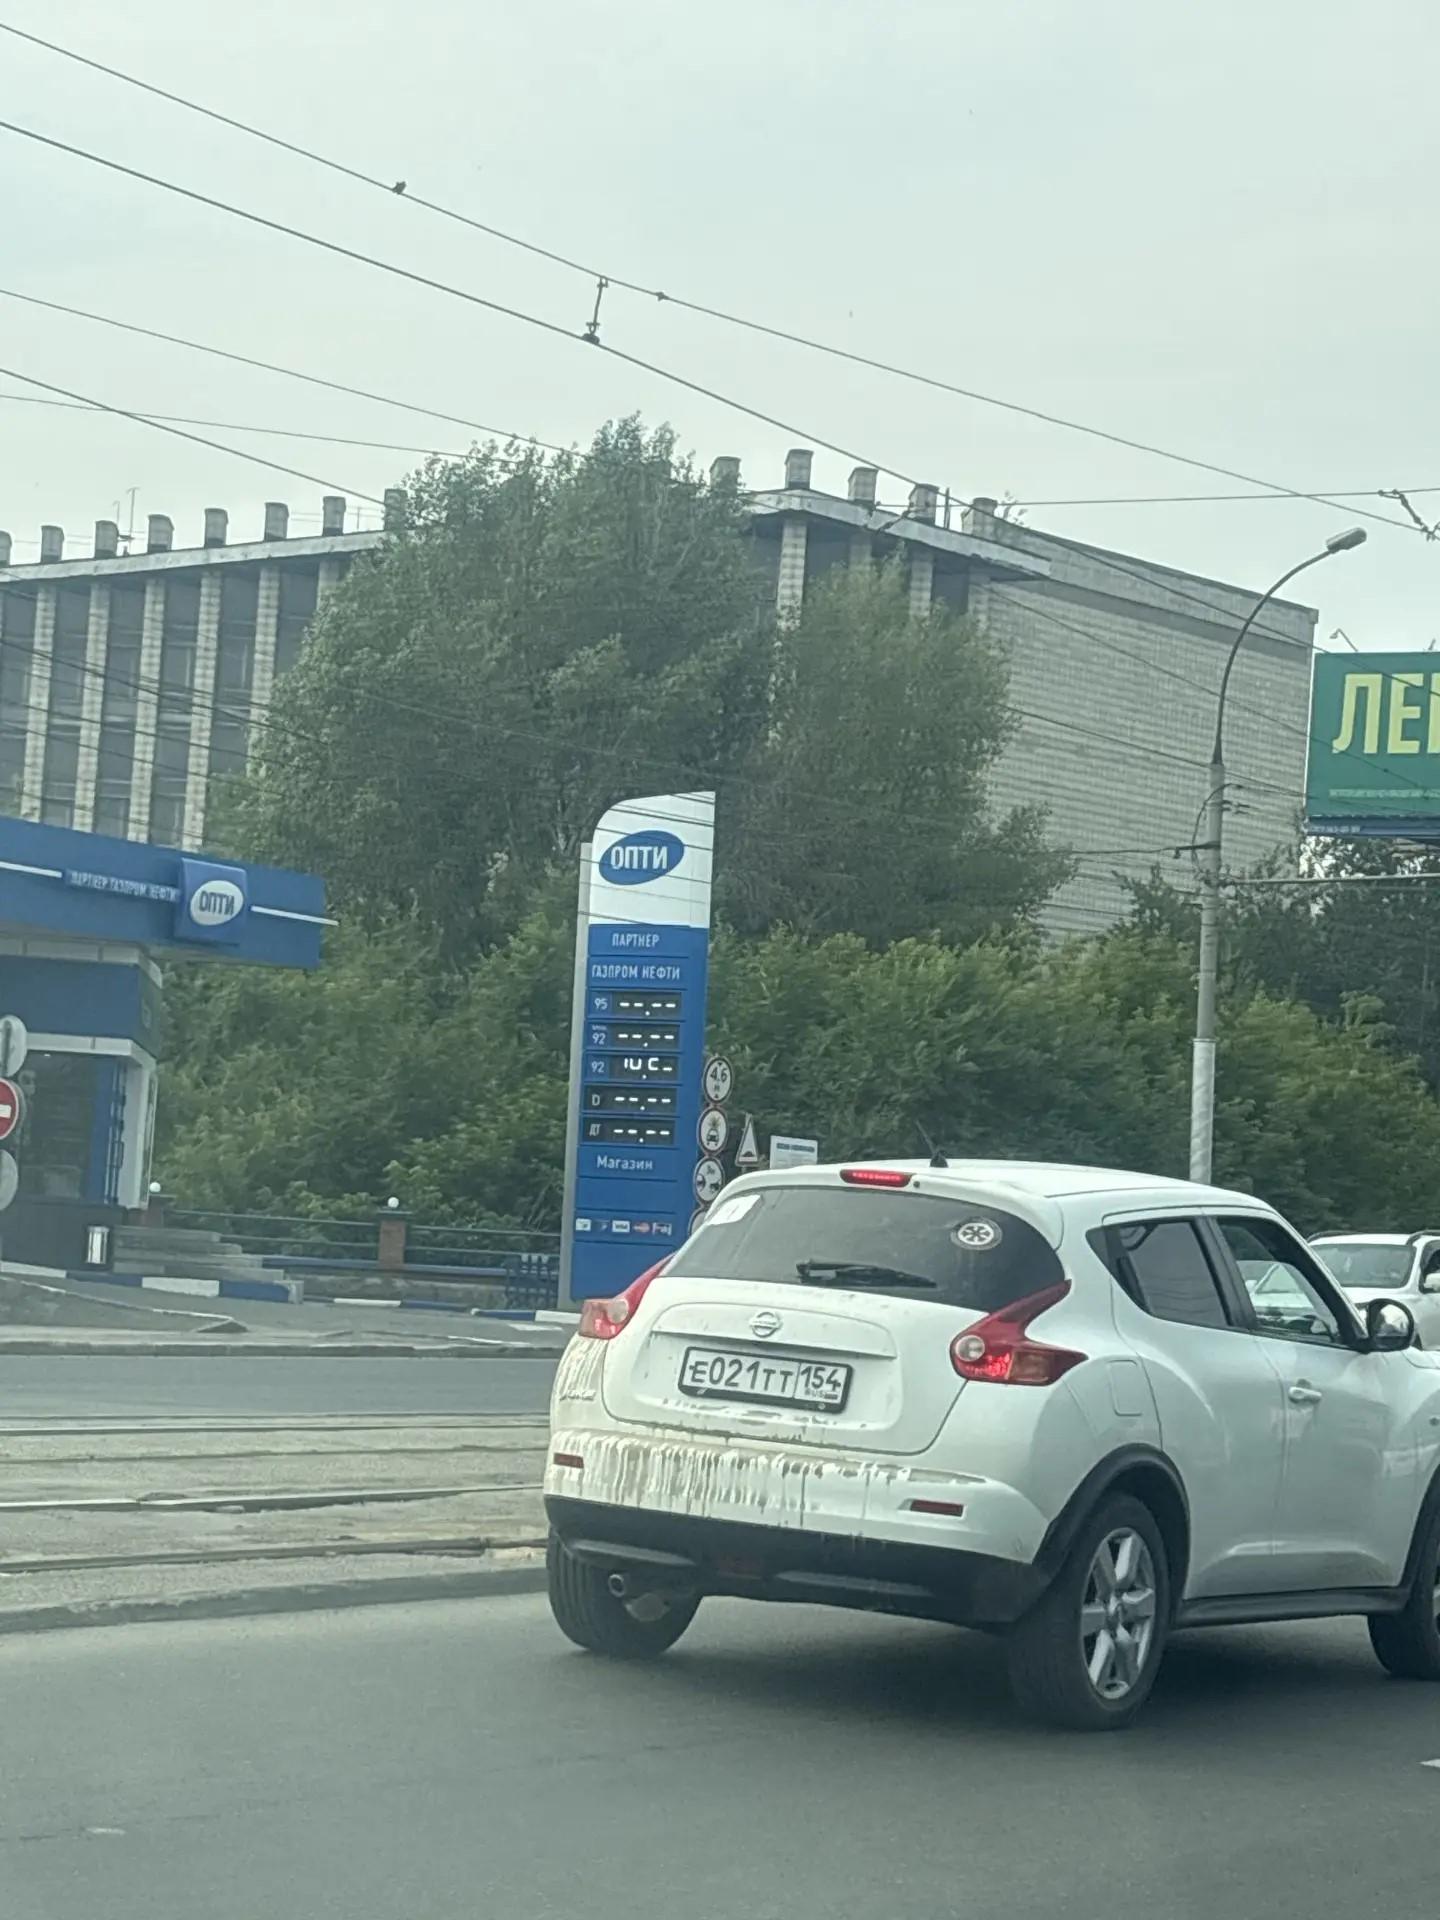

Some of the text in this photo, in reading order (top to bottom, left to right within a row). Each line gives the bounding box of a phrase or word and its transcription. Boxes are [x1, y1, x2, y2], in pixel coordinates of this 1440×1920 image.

[1332, 673, 1440, 754] ЛЕ
[610, 846, 668, 870] ОПТИ
[199, 891, 235, 915] ОПТИ
[612, 934, 660, 948] ПАРТНЕР
[592, 965, 680, 980] ГАЗПРОМ НЕФТИ
[594, 998, 608, 1010] 95
[592, 1033, 606, 1045] 92
[591, 1061, 605, 1073] 92
[592, 1094, 600, 1106] D
[597, 1155, 653, 1171] Магазин
[800, 1365, 841, 1392] 154
